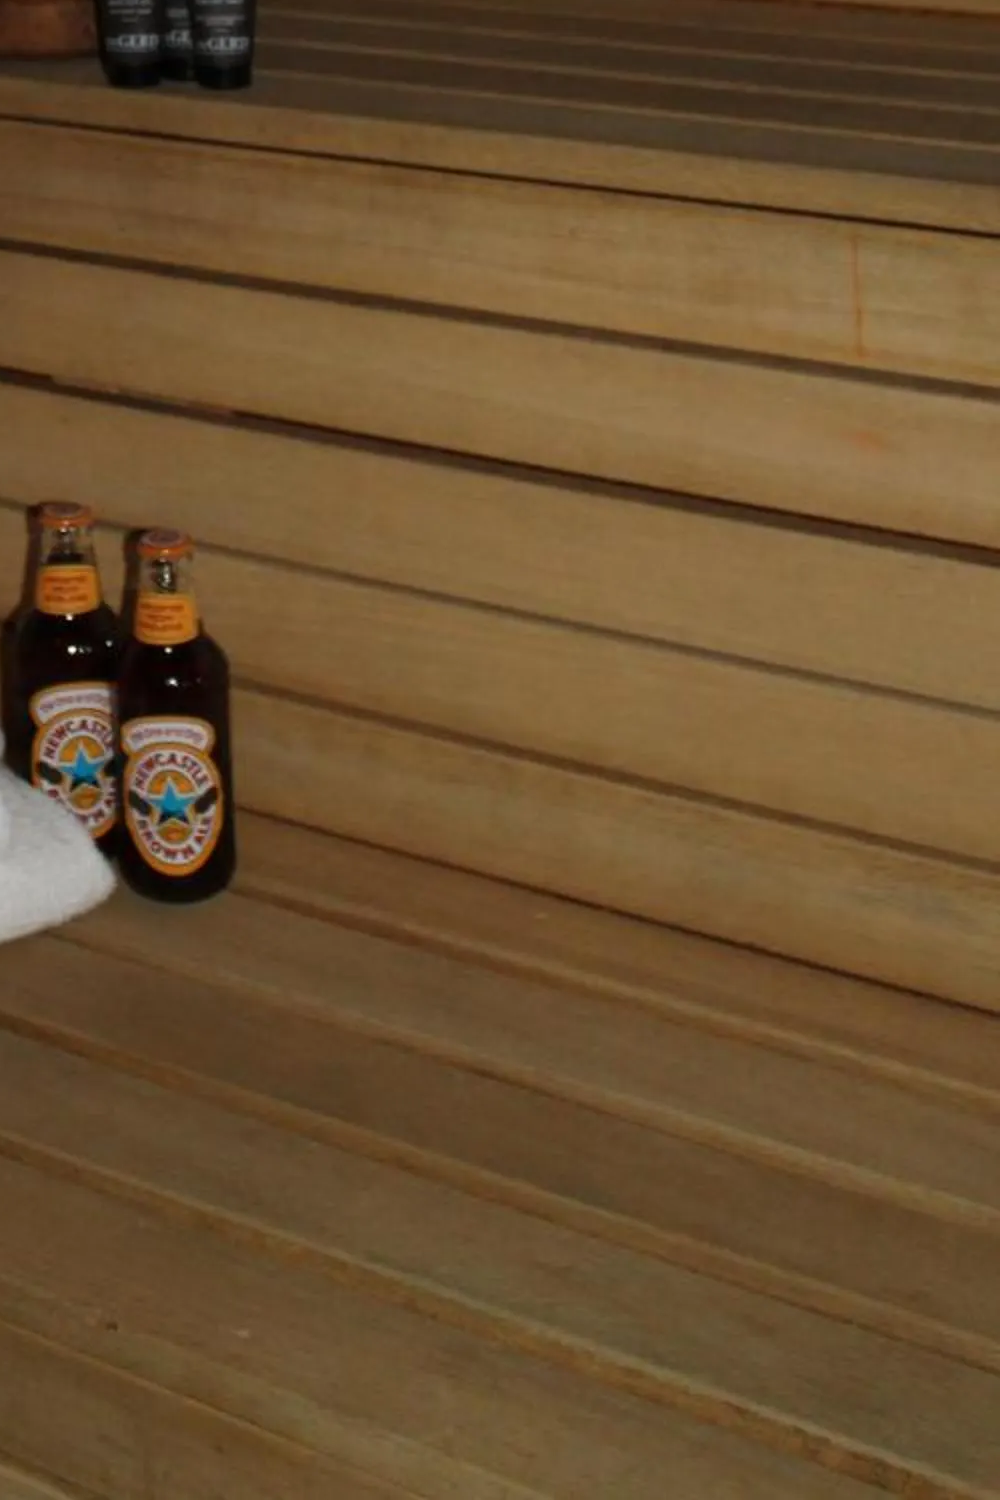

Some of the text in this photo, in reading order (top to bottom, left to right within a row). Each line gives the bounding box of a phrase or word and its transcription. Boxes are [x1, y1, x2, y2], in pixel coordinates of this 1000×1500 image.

[135, 752, 209, 791] NEWCASTLE
[137, 815, 212, 861] BROWN ALE
